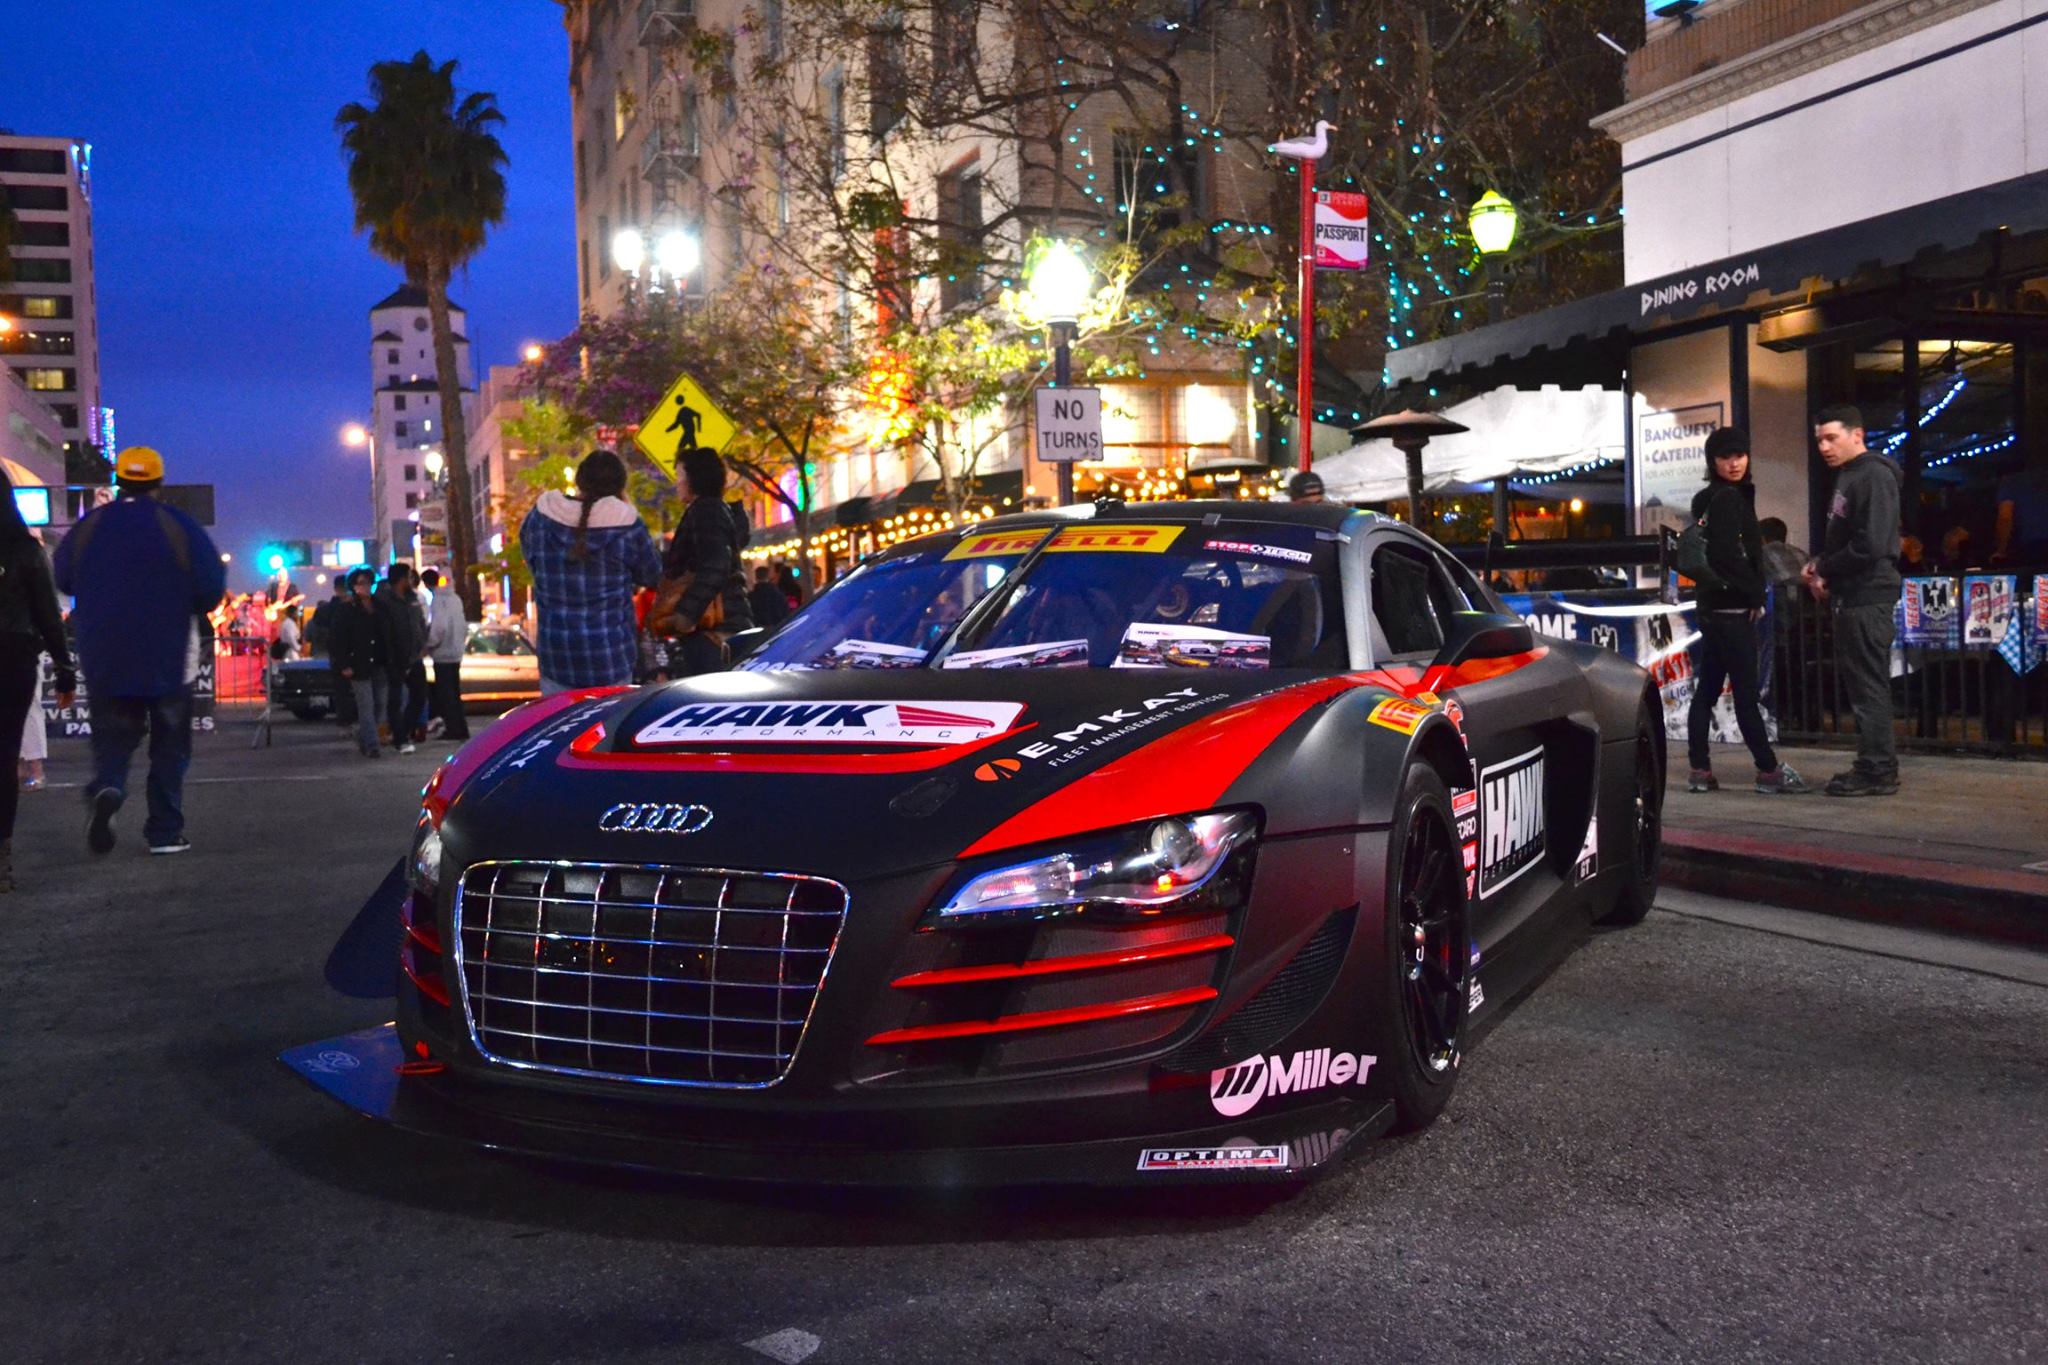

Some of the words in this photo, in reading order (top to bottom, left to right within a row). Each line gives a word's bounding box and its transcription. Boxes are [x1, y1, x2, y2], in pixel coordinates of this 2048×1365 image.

[1316, 223, 1366, 242] PASSPORT
[1641, 280, 1698, 317] DINING
[1705, 263, 1759, 294] ROOM
[1054, 399, 1084, 420] NO
[1042, 431, 1099, 449] TURNS
[1644, 421, 1716, 443] BANQUETS
[1651, 446, 1706, 463] CATERIN
[968, 529, 1158, 553] PIRELLI
[1206, 540, 1250, 551] STOP
[1904, 580, 1920, 629] TECATE
[656, 705, 888, 728] HAWK
[1017, 687, 1199, 759] EMKAY
[645, 729, 991, 740] PERFORMANCE
[1048, 745, 1091, 767] FLEET
[1091, 710, 1175, 747] MANAGEMENT
[1267, 1047, 1378, 1097] Miller
[1152, 1149, 1277, 1161] OPTIMA
